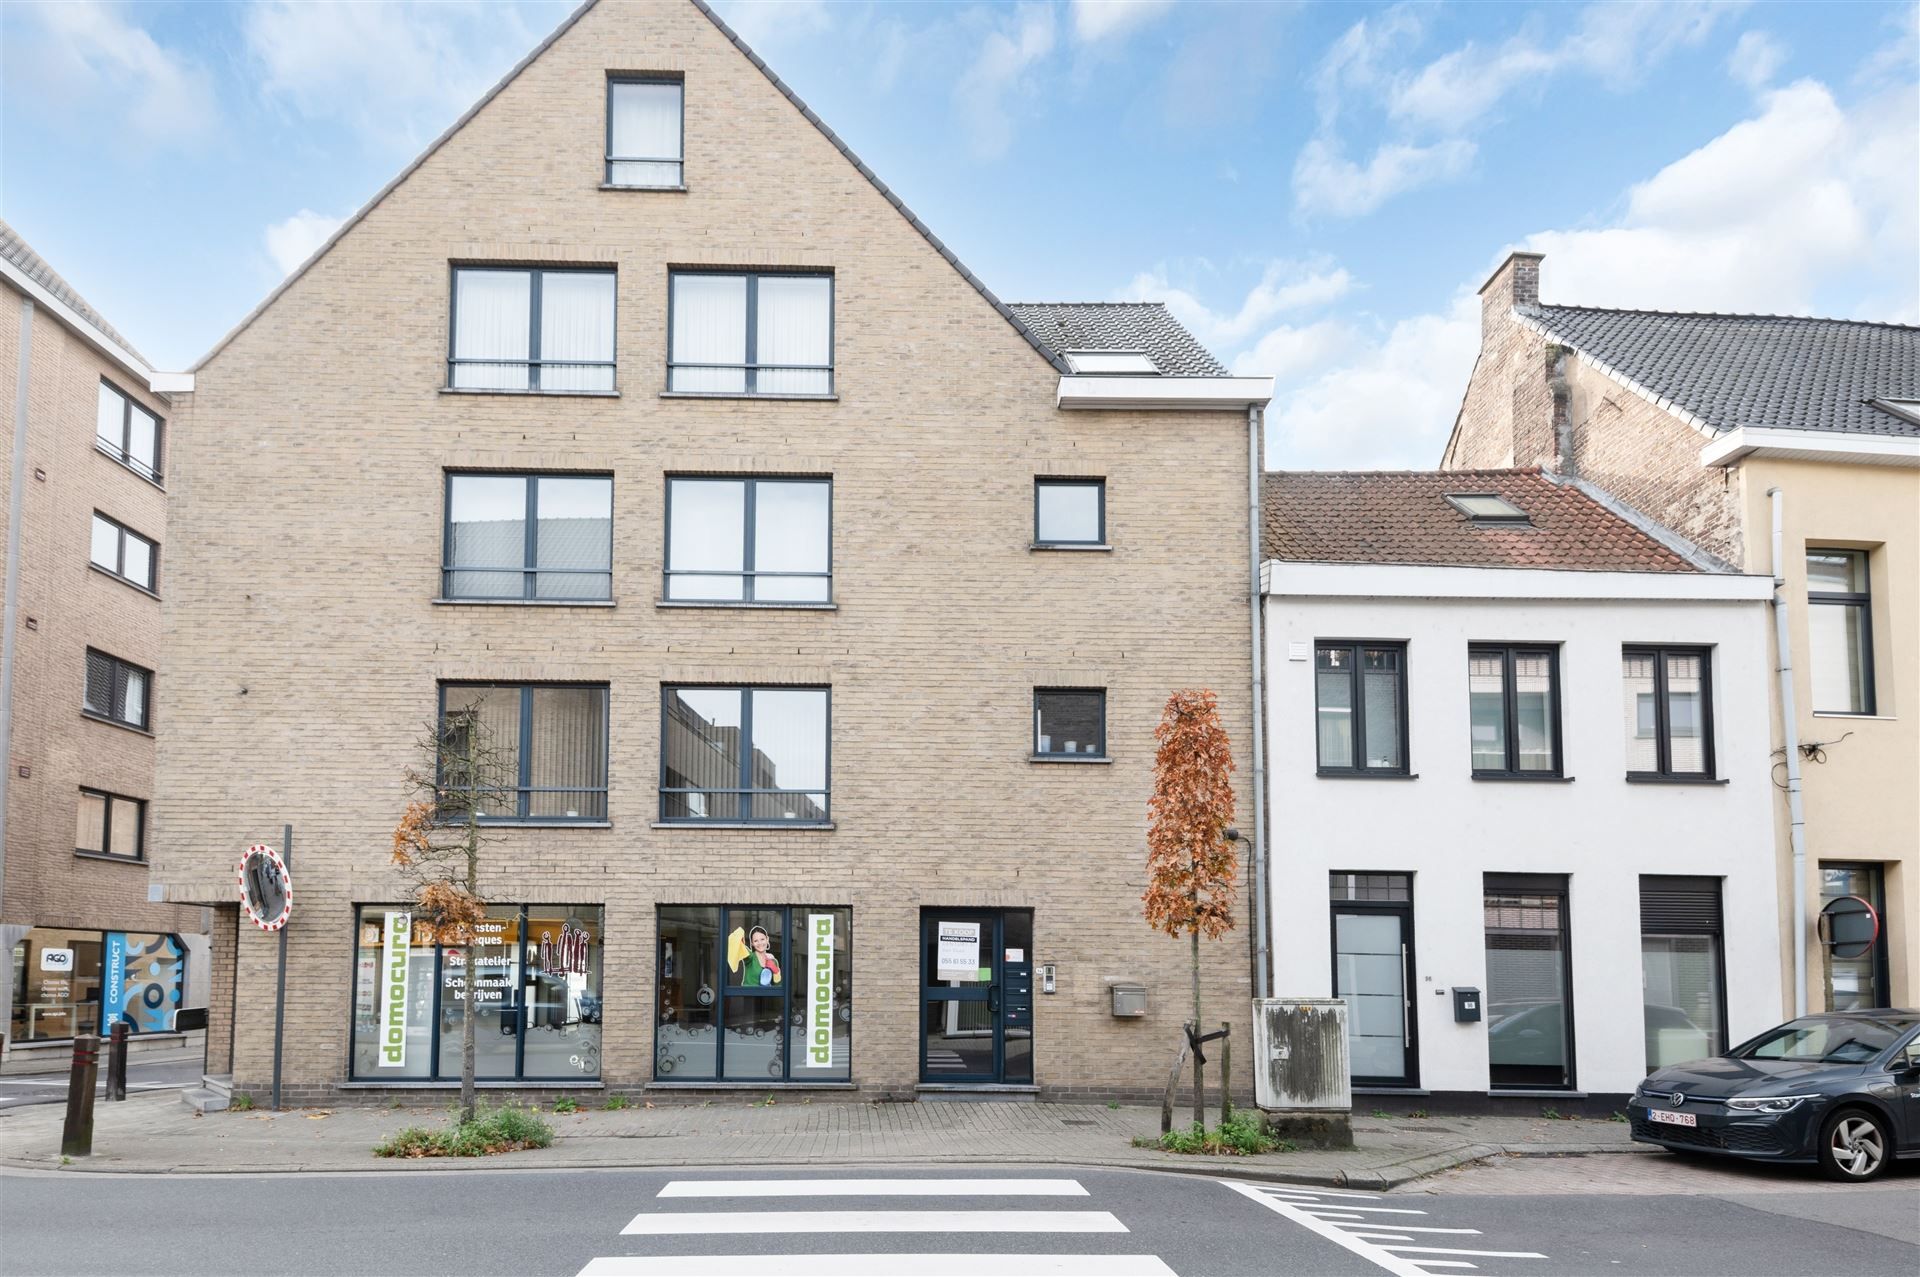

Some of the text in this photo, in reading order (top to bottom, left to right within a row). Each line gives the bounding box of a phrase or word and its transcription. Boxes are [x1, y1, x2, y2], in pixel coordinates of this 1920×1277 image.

[46, 953, 67, 963] AGO
[109, 940, 121, 1004] CONSTRUCT
[383, 916, 409, 1062] domocura
[454, 990, 502, 1001] berijven
[810, 919, 831, 1063] domocura
